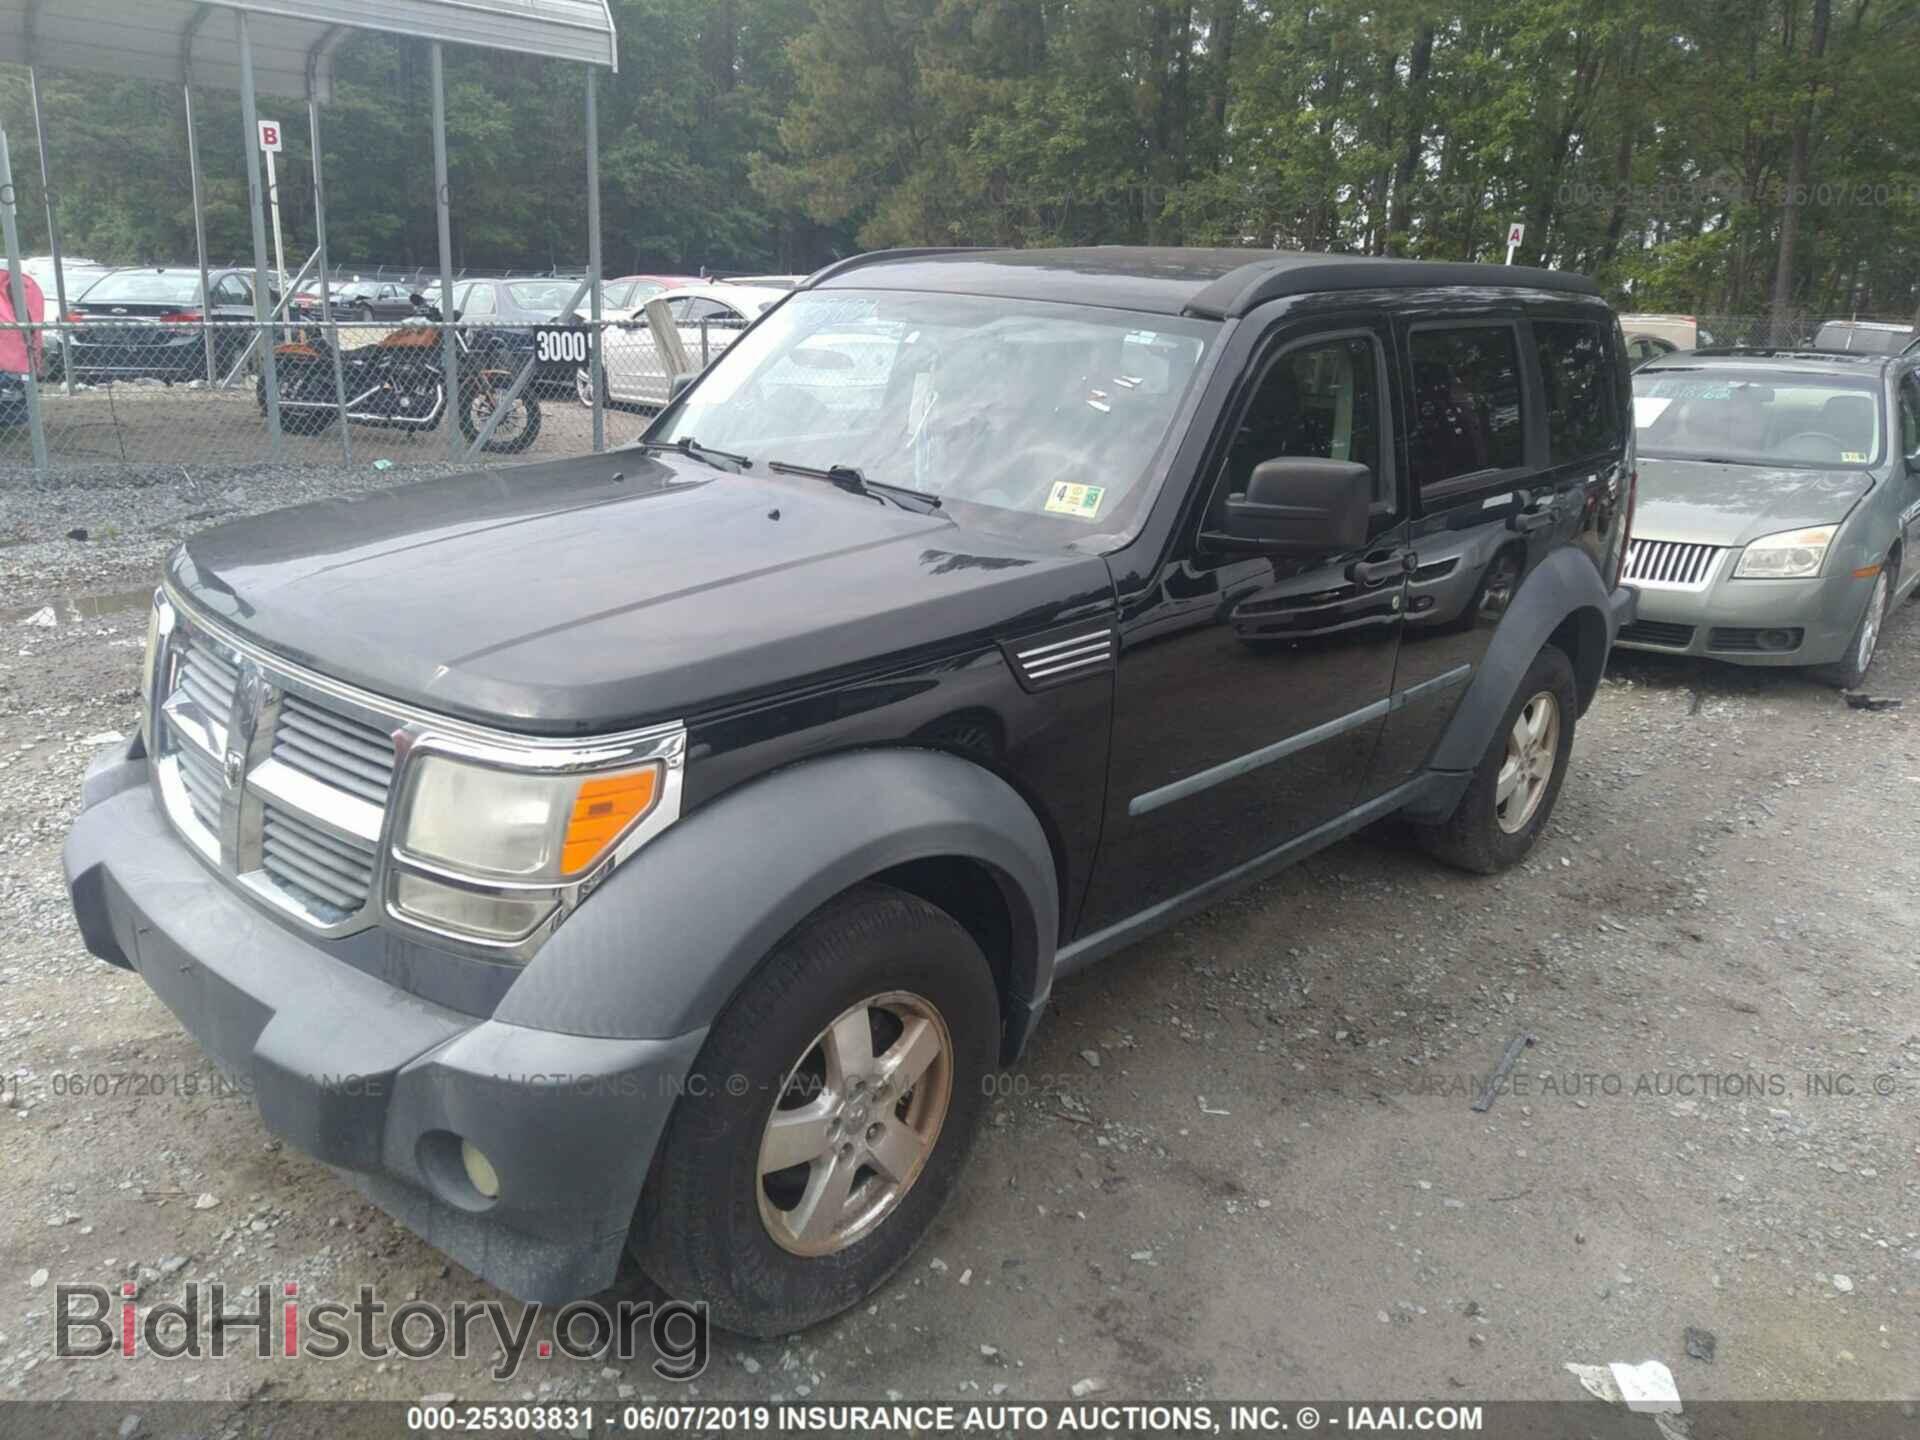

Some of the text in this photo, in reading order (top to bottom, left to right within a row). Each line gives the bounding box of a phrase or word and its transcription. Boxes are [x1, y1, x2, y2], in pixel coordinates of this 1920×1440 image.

[263, 127, 278, 145] B
[1510, 228, 1521, 242] A
[536, 331, 586, 362] 3000
